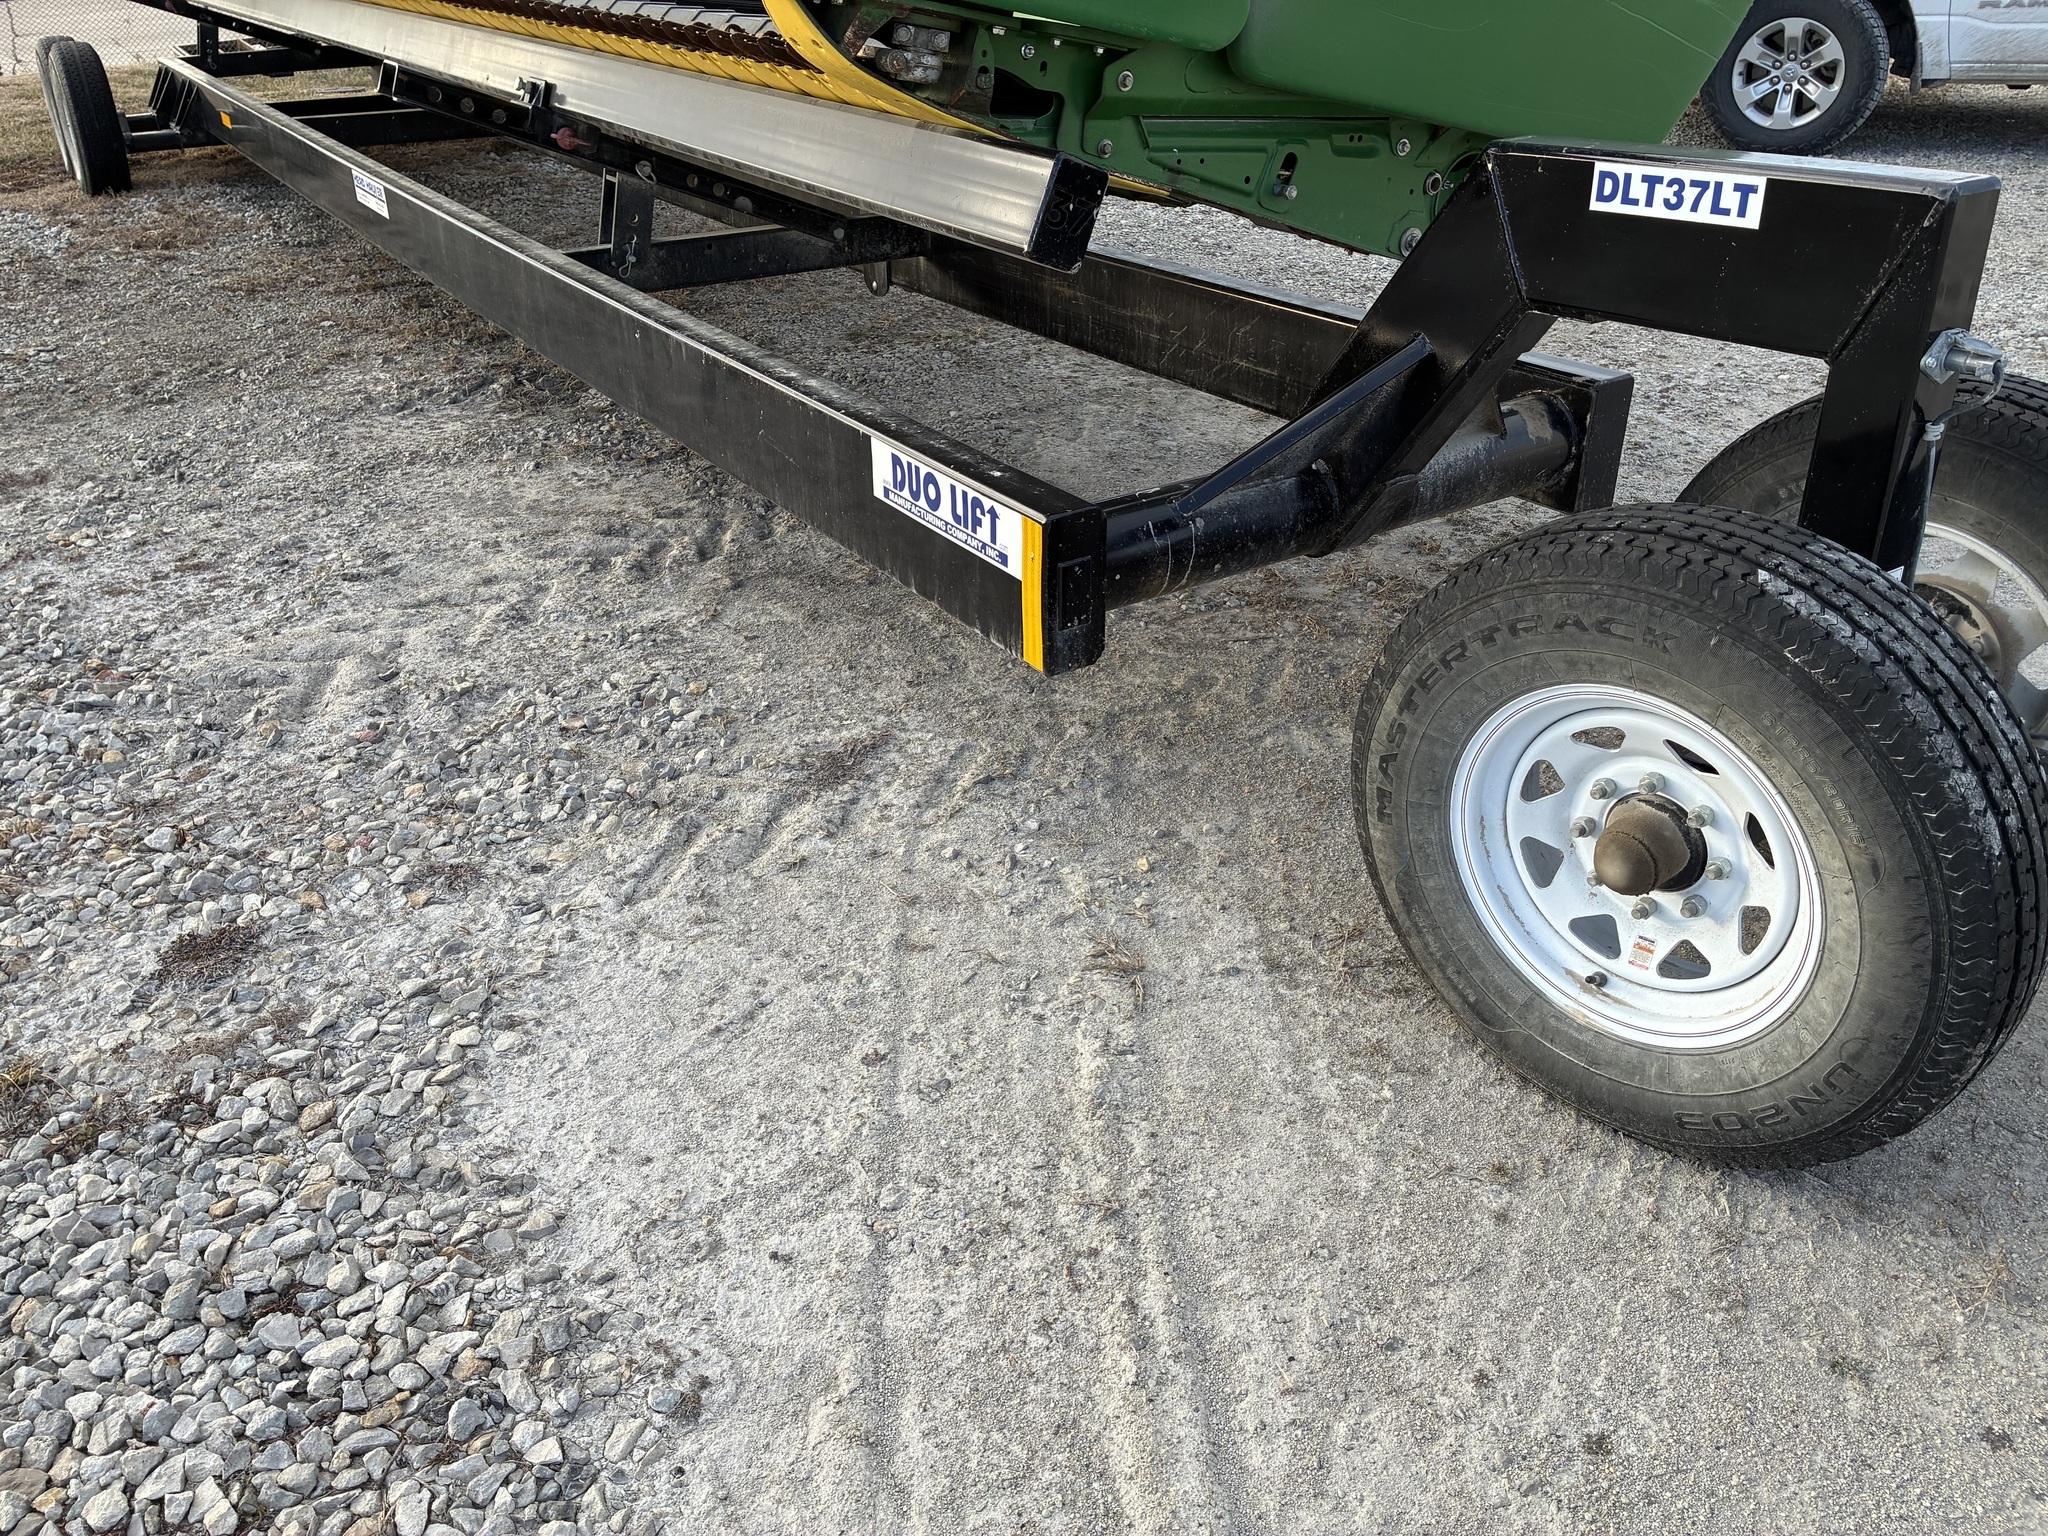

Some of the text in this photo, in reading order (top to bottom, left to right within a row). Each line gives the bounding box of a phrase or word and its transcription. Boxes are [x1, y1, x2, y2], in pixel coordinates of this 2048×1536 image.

[1595, 170, 1759, 219] DLT37LT
[891, 452, 941, 512] DUO
[889, 491, 1002, 562] MANUFACTURING COMPANY, INC.
[1376, 613, 1679, 826] MASTERTRACK
[1761, 712, 1866, 845] ST235/80R16
[1673, 1060, 1861, 1130] UN203
